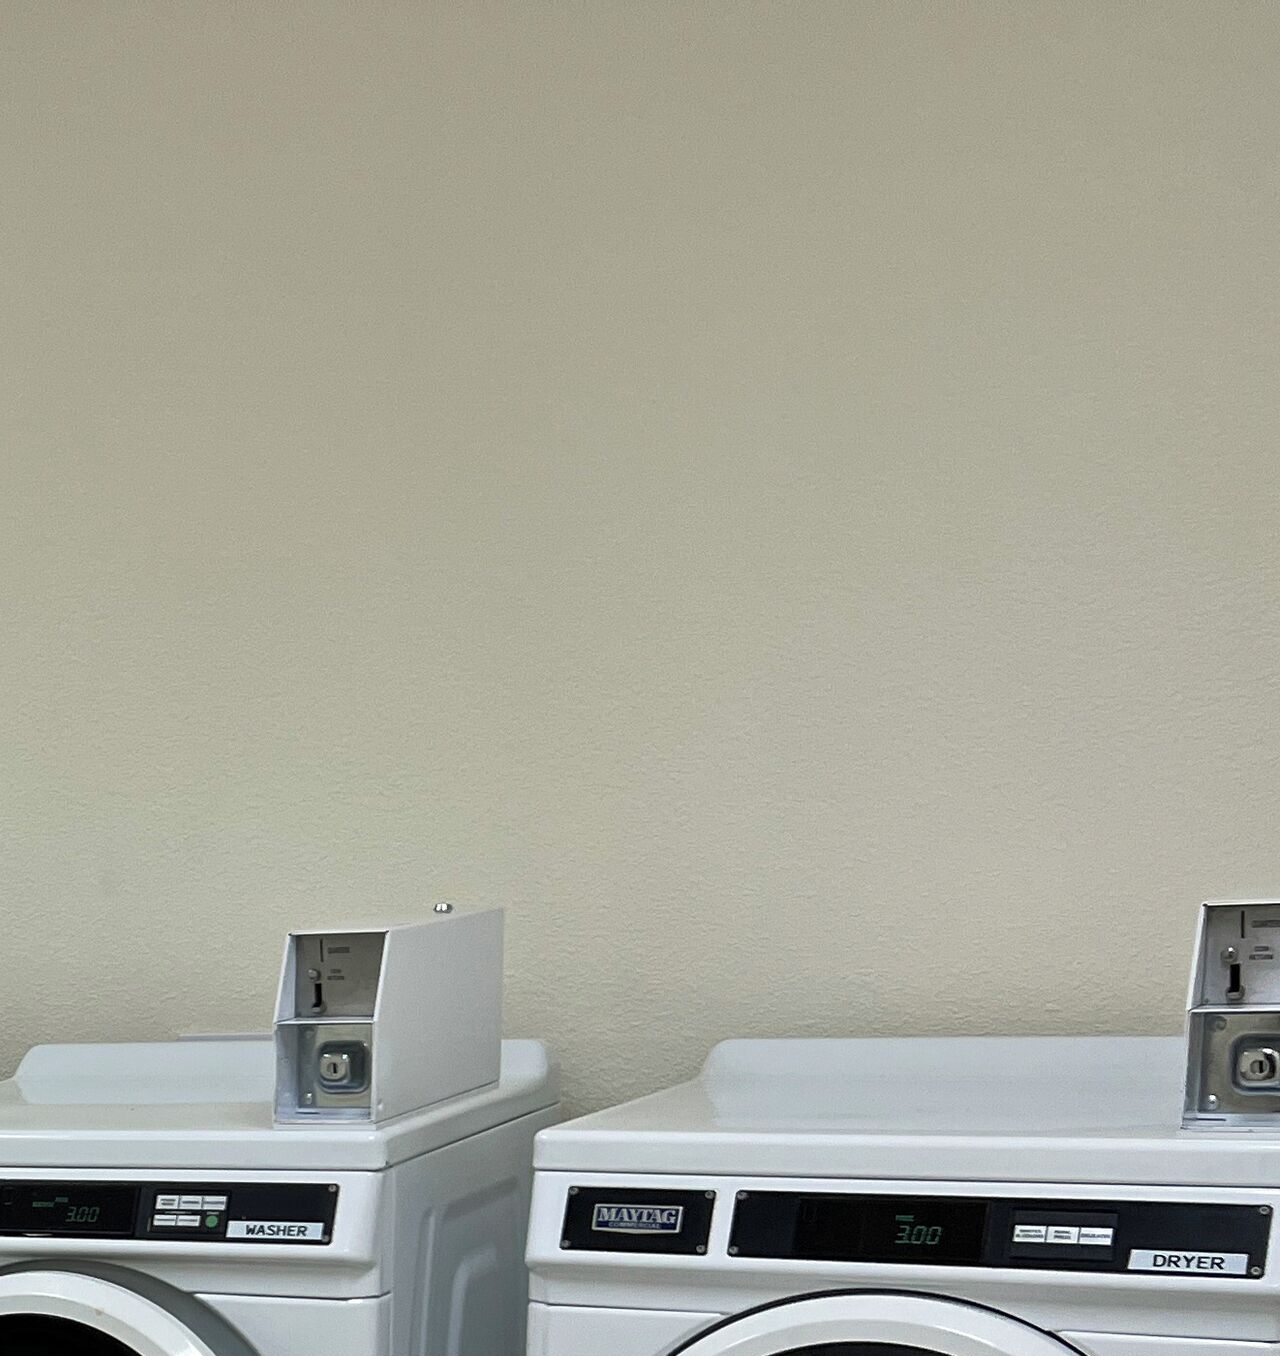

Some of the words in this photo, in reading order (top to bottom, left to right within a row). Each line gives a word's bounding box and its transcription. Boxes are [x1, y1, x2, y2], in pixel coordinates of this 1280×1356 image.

[597, 1207, 677, 1224] MAYTAG
[245, 1224, 308, 1237] WASHER
[608, 1221, 660, 1229] COMMERCIAL
[1153, 1254, 1226, 1270] DRYER
